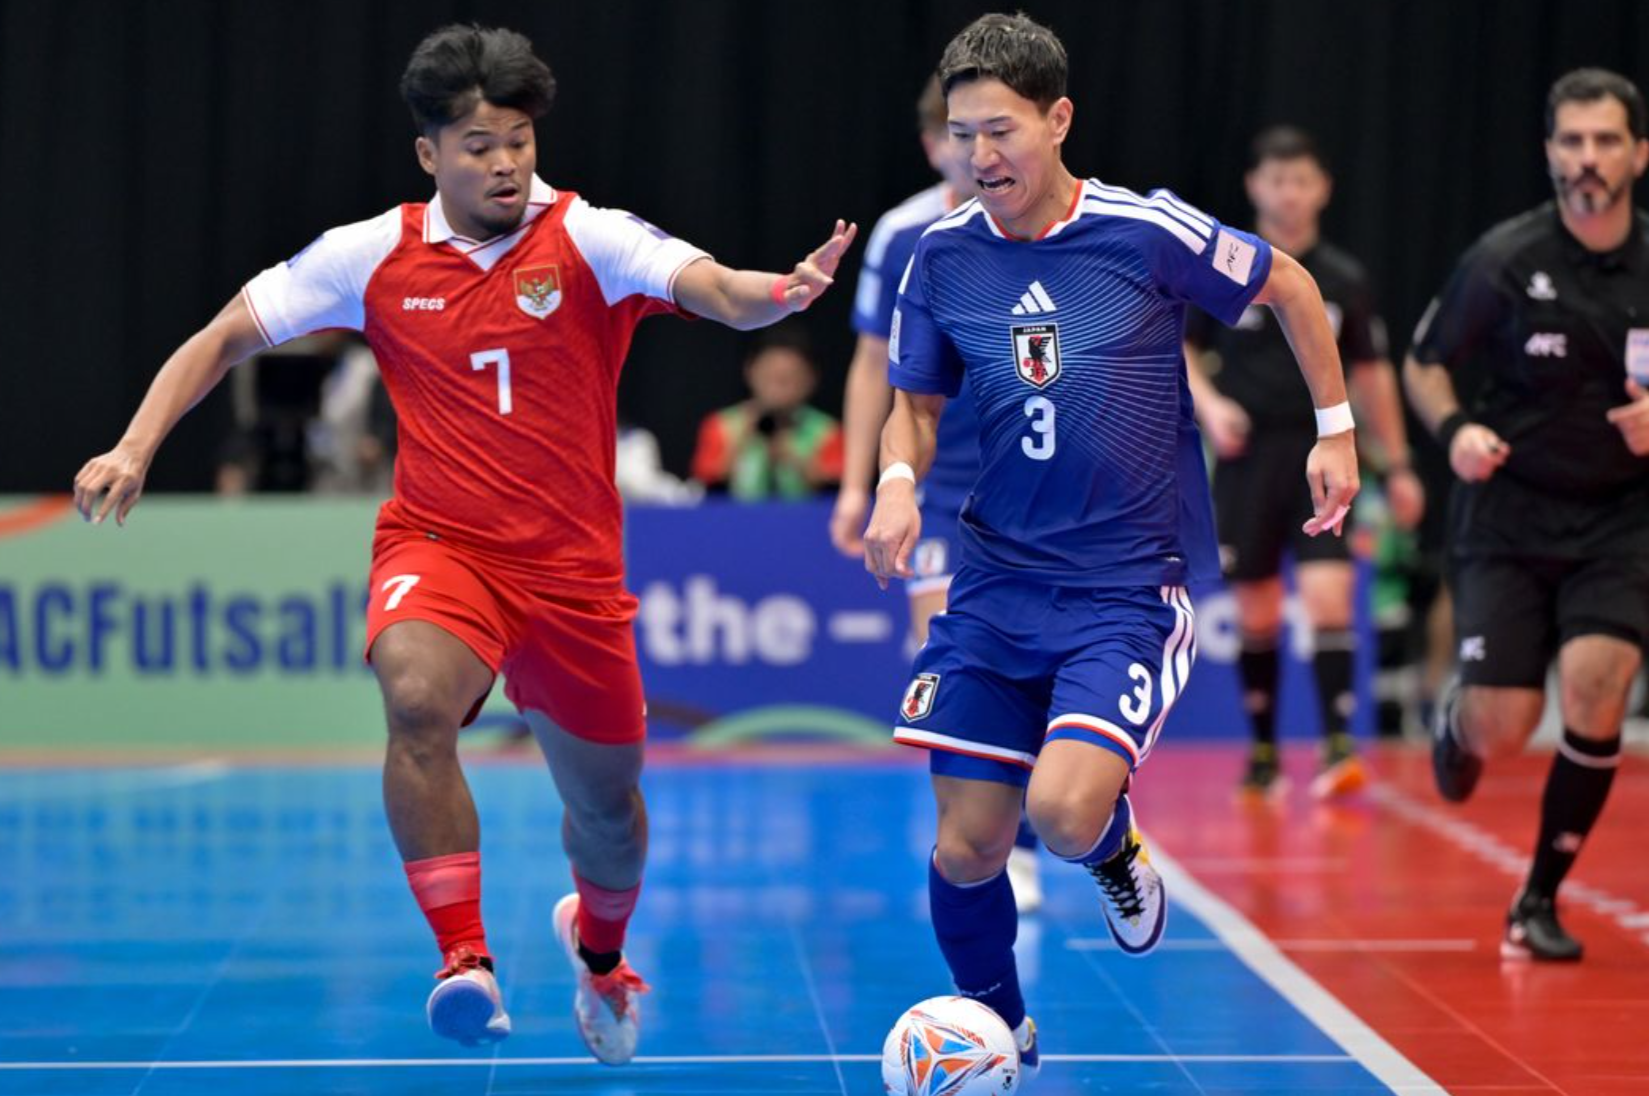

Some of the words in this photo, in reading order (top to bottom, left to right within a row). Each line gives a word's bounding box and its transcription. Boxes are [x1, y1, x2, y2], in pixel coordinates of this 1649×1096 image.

[402, 297, 446, 311] SPECS
[1524, 333, 1567, 358] AFC
[470, 347, 513, 415] 7
[1021, 395, 1056, 461] 3
[382, 574, 421, 611] 7
[641, 577, 814, 665] the
[0, 582, 368, 674] ACFutsal
[1119, 662, 1152, 726] 3
